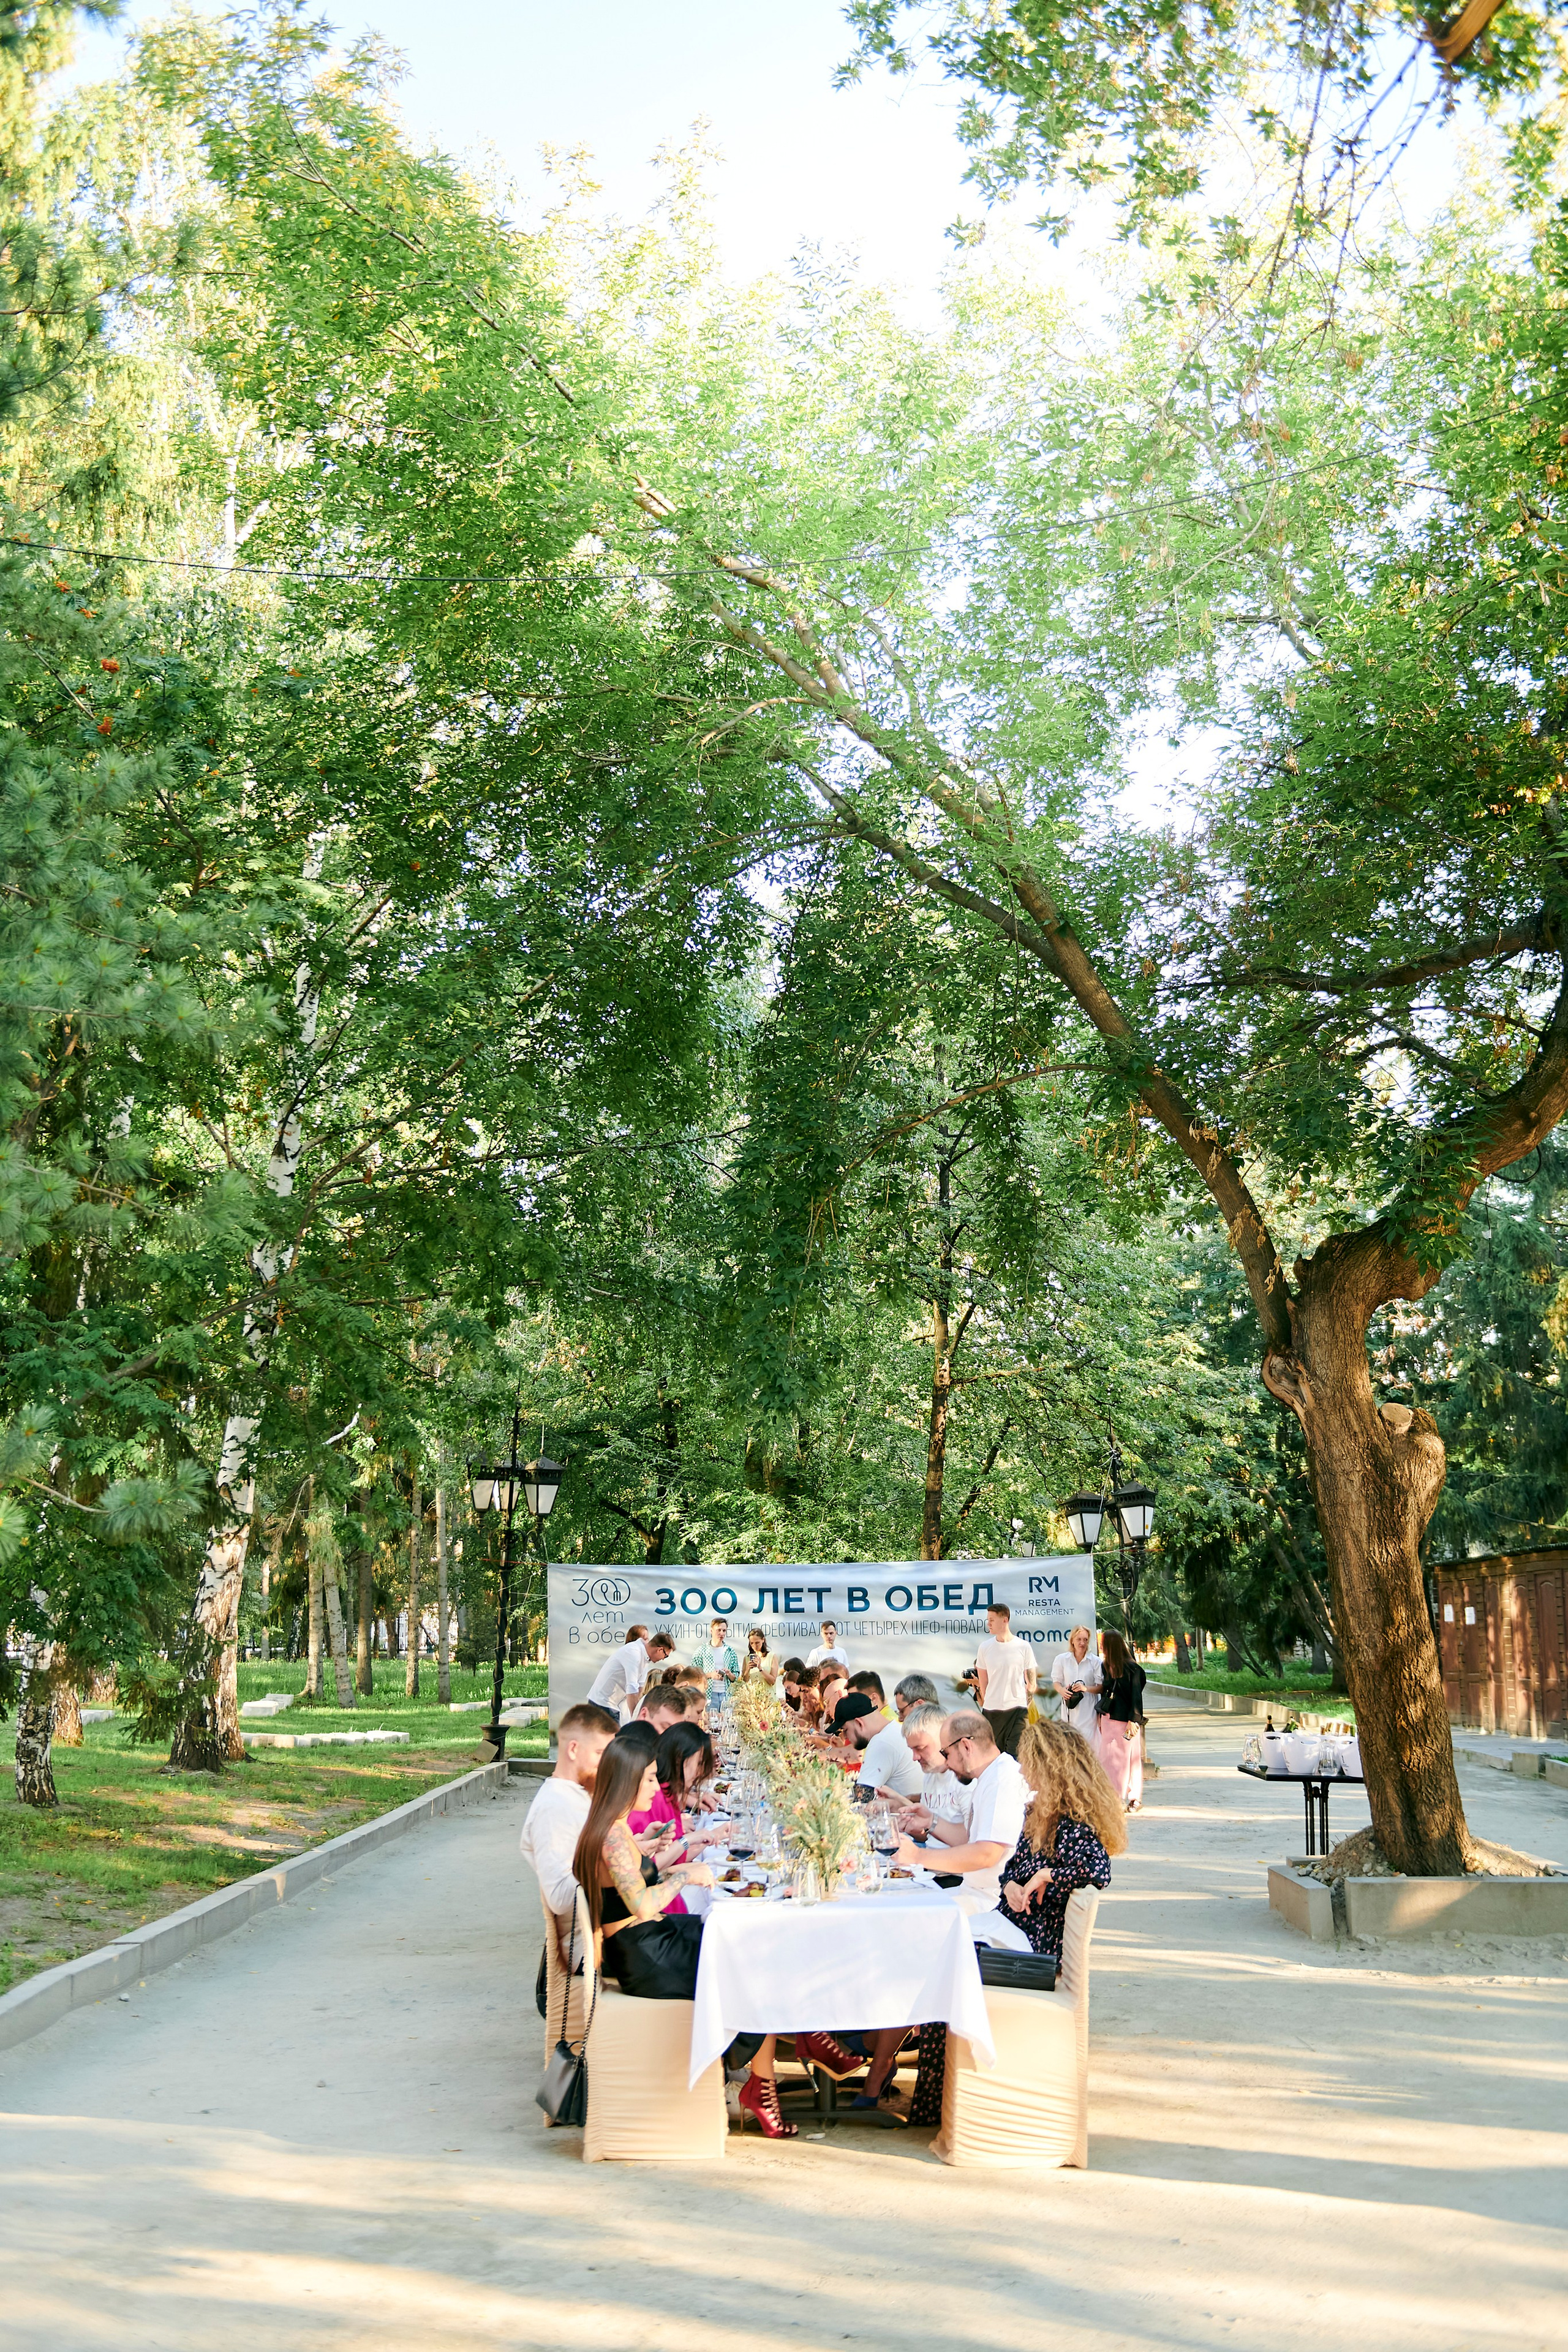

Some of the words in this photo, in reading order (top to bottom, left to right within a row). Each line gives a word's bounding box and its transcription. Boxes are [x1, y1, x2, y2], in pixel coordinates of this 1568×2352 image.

[1028, 1576, 1060, 1593] RM
[654, 1588, 737, 1615] 300
[752, 1587, 832, 1614] ЛЕТ
[847, 1586, 870, 1612] В
[884, 1583, 993, 1615] ОБЕД
[582, 1611, 625, 1623] лет
[587, 1626, 625, 1643] обе
[760, 1621, 824, 1637] ФЕСТИВАЛ
[835, 1621, 851, 1636] ОТ
[854, 1620, 908, 1635] ЧЕТЫРЕХ
[911, 1619, 990, 1635] ШЕФ-ПОВАРО
